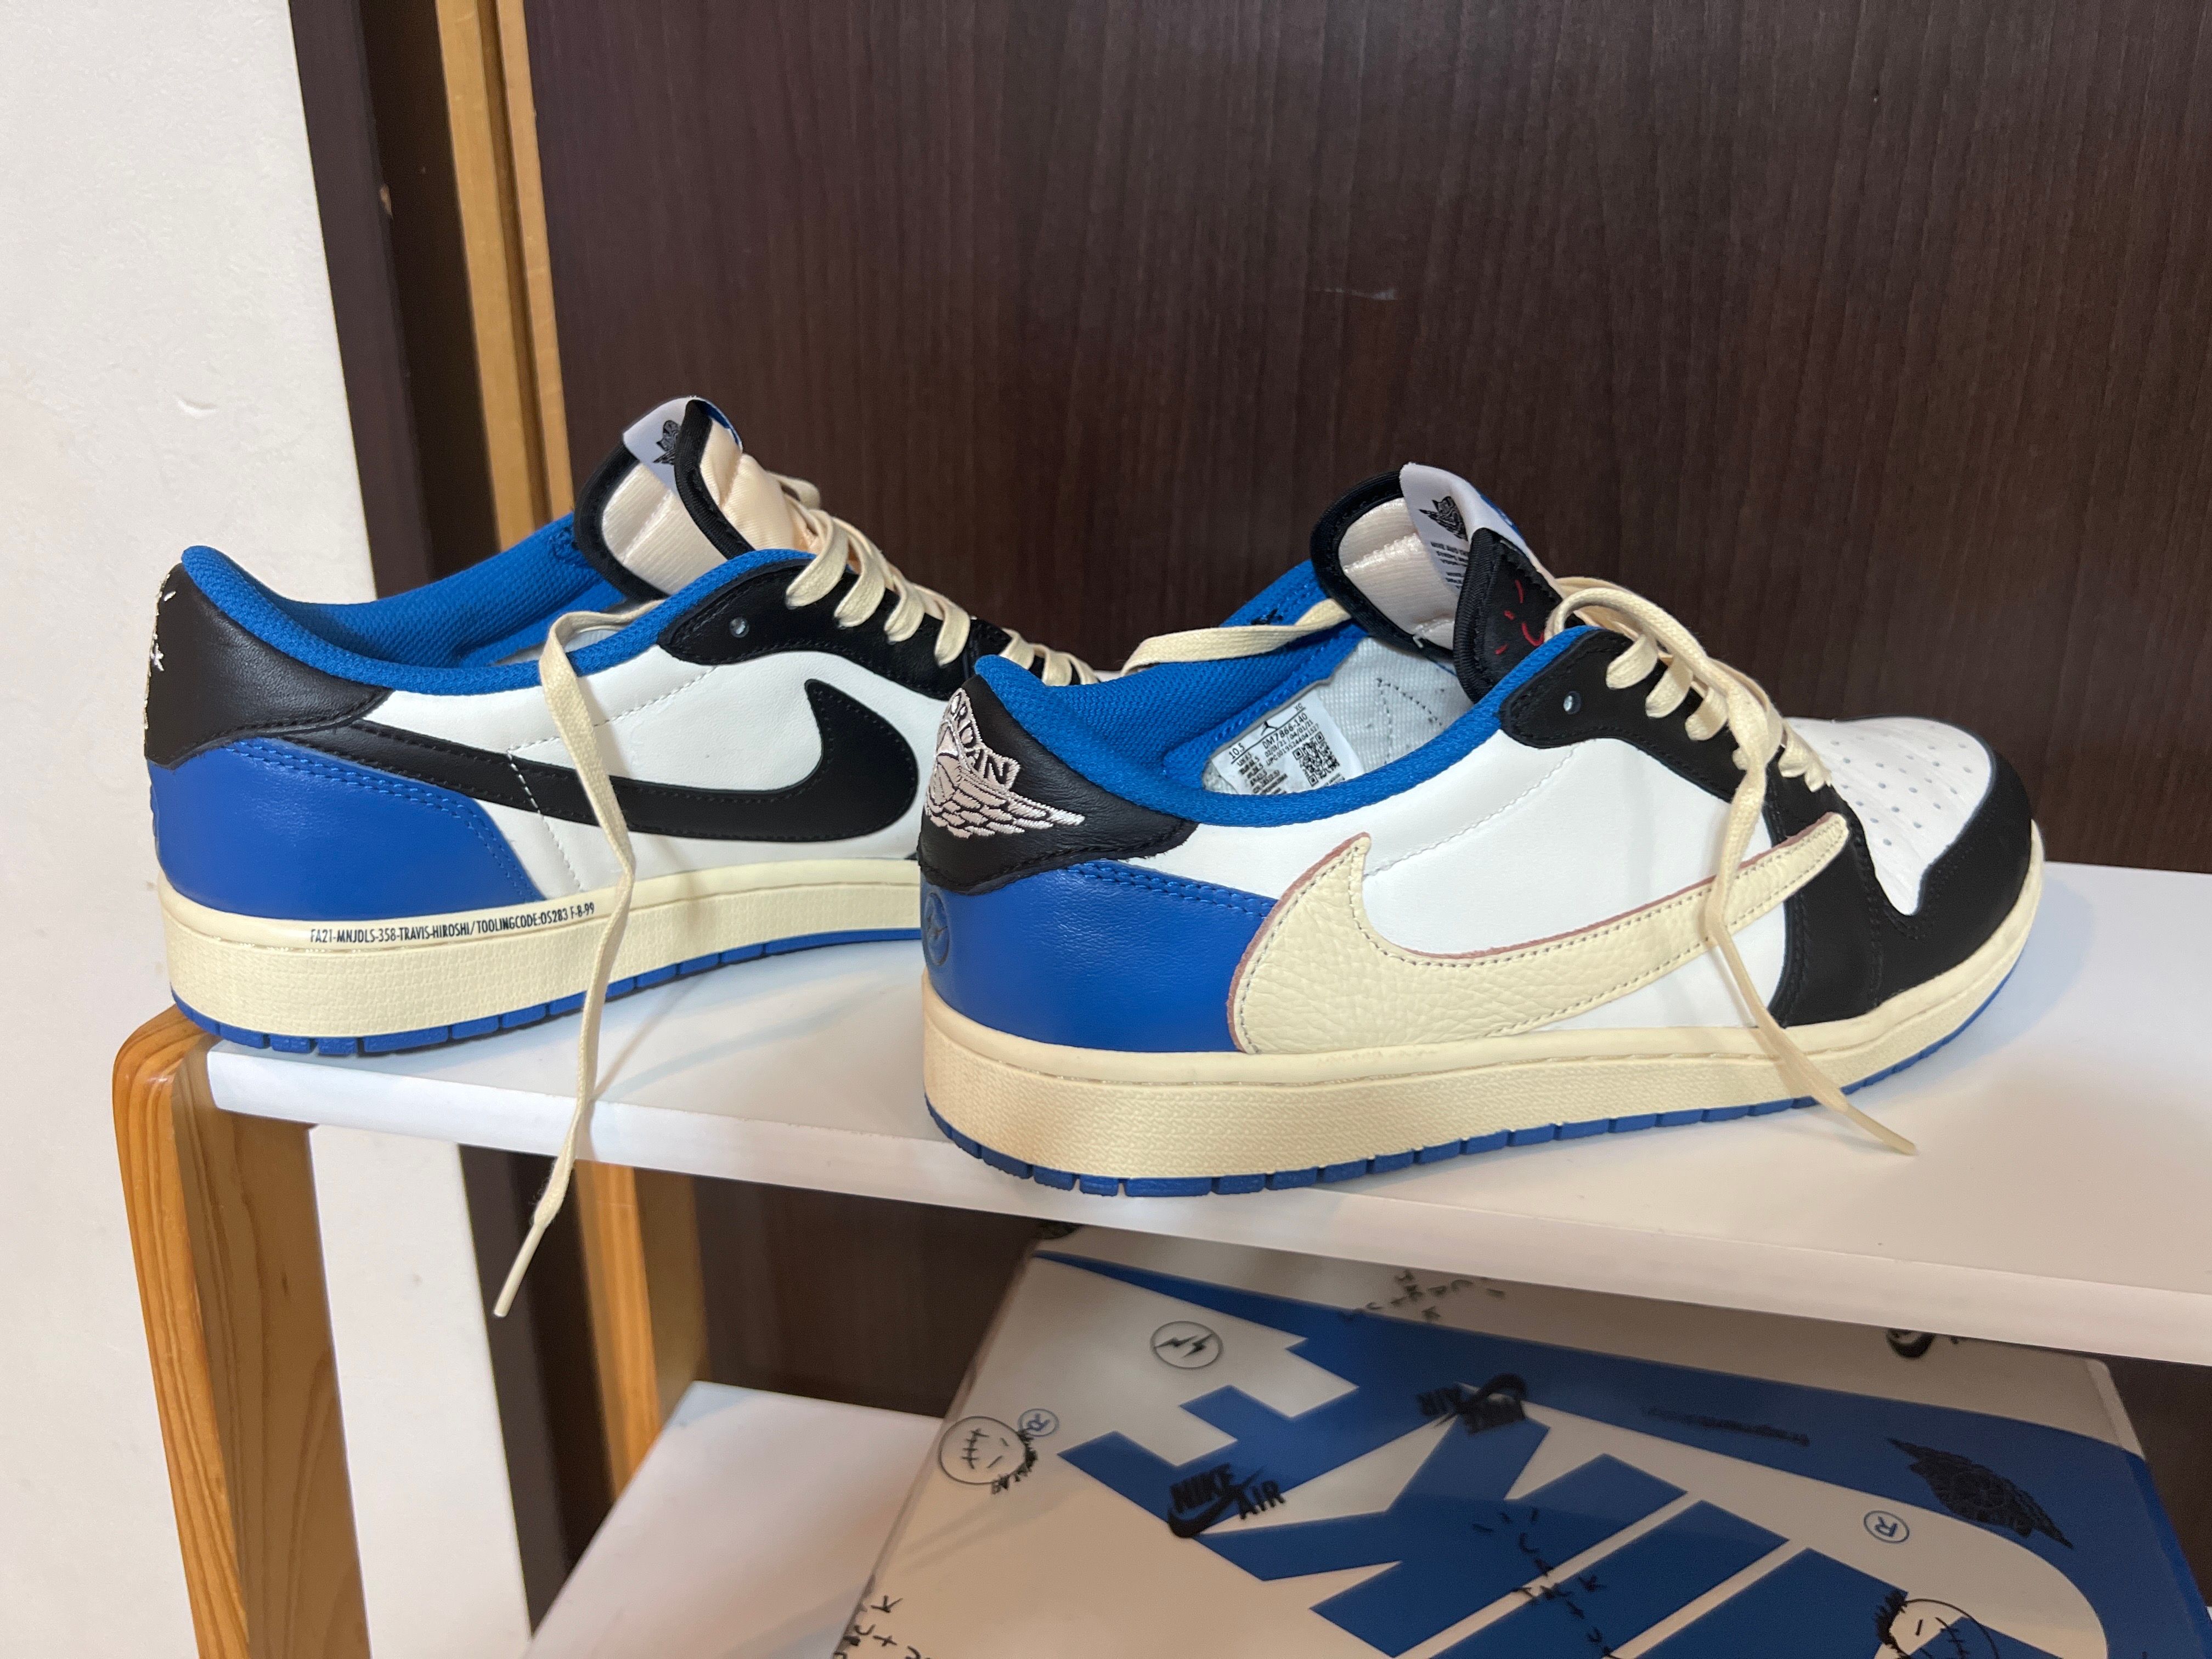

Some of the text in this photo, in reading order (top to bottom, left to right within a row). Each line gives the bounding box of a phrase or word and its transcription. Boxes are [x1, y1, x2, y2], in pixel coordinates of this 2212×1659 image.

[1262, 713, 1308, 749] DM7866-140
[1229, 743, 1245, 759] 10.5
[1169, 1463, 1234, 1514] NIKE
[1237, 1479, 1286, 1520] AIR
